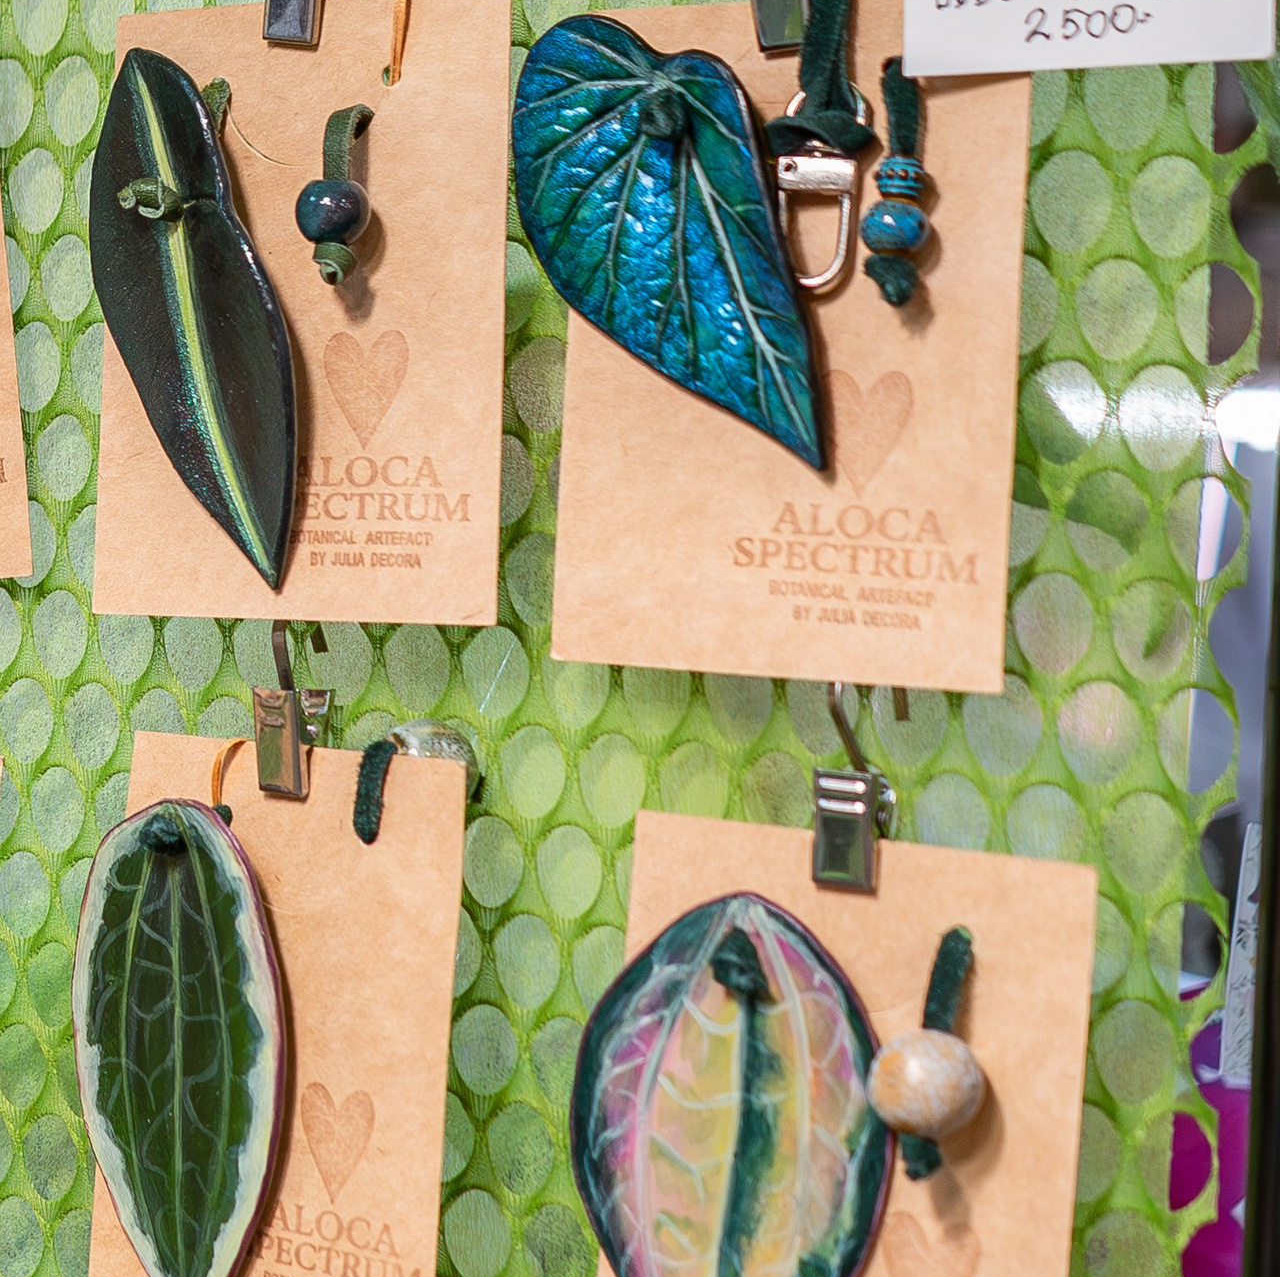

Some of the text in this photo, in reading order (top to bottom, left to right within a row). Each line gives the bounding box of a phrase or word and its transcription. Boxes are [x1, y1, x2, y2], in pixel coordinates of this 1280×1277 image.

[297, 492, 471, 522] ECTRUM
[771, 501, 947, 545] ALOCA
[310, 552, 422, 568] BY JULIA DECORA
[733, 536, 978, 585] SPECTRUM
[270, 1201, 400, 1258] ALOCA
